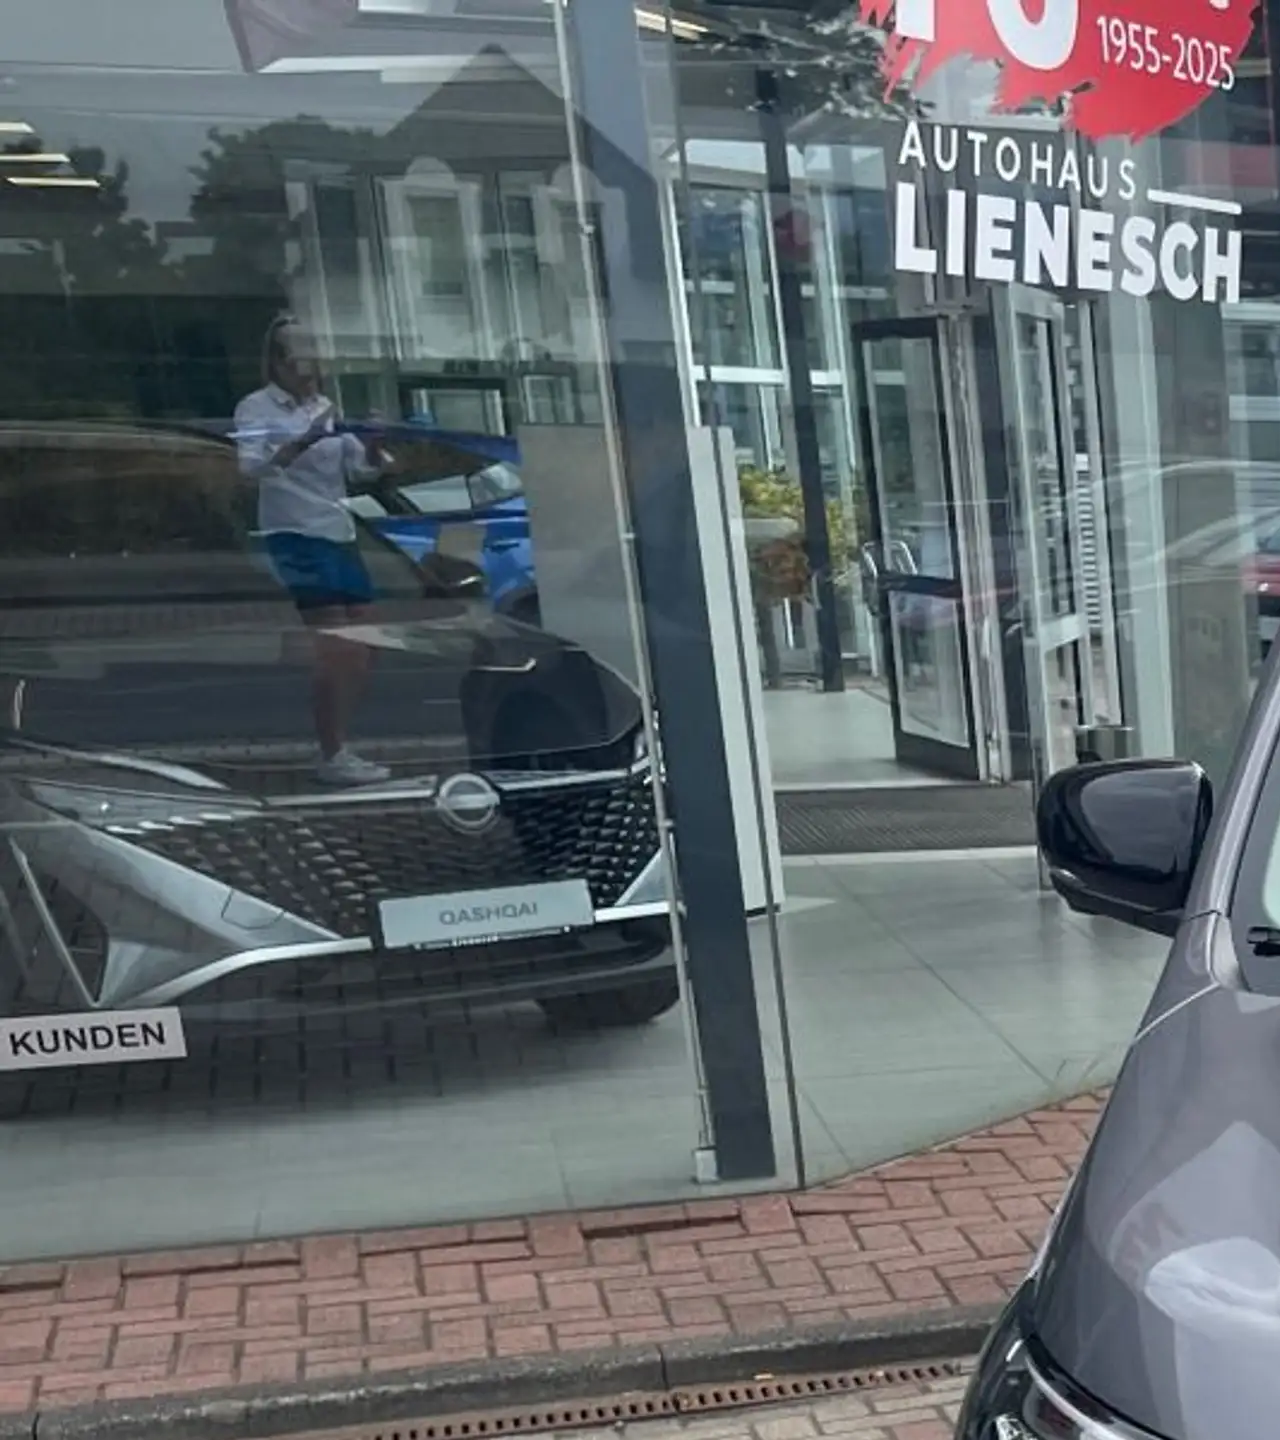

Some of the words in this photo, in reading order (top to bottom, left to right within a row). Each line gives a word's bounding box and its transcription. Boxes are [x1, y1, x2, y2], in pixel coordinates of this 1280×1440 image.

[1096, 15, 1235, 91] 1955-2025
[898, 119, 1137, 201] AUTOHAUS
[894, 181, 1243, 304] LIENESCH
[438, 901, 538, 926] QASHQAI
[9, 1021, 166, 1057] KUNDEN
